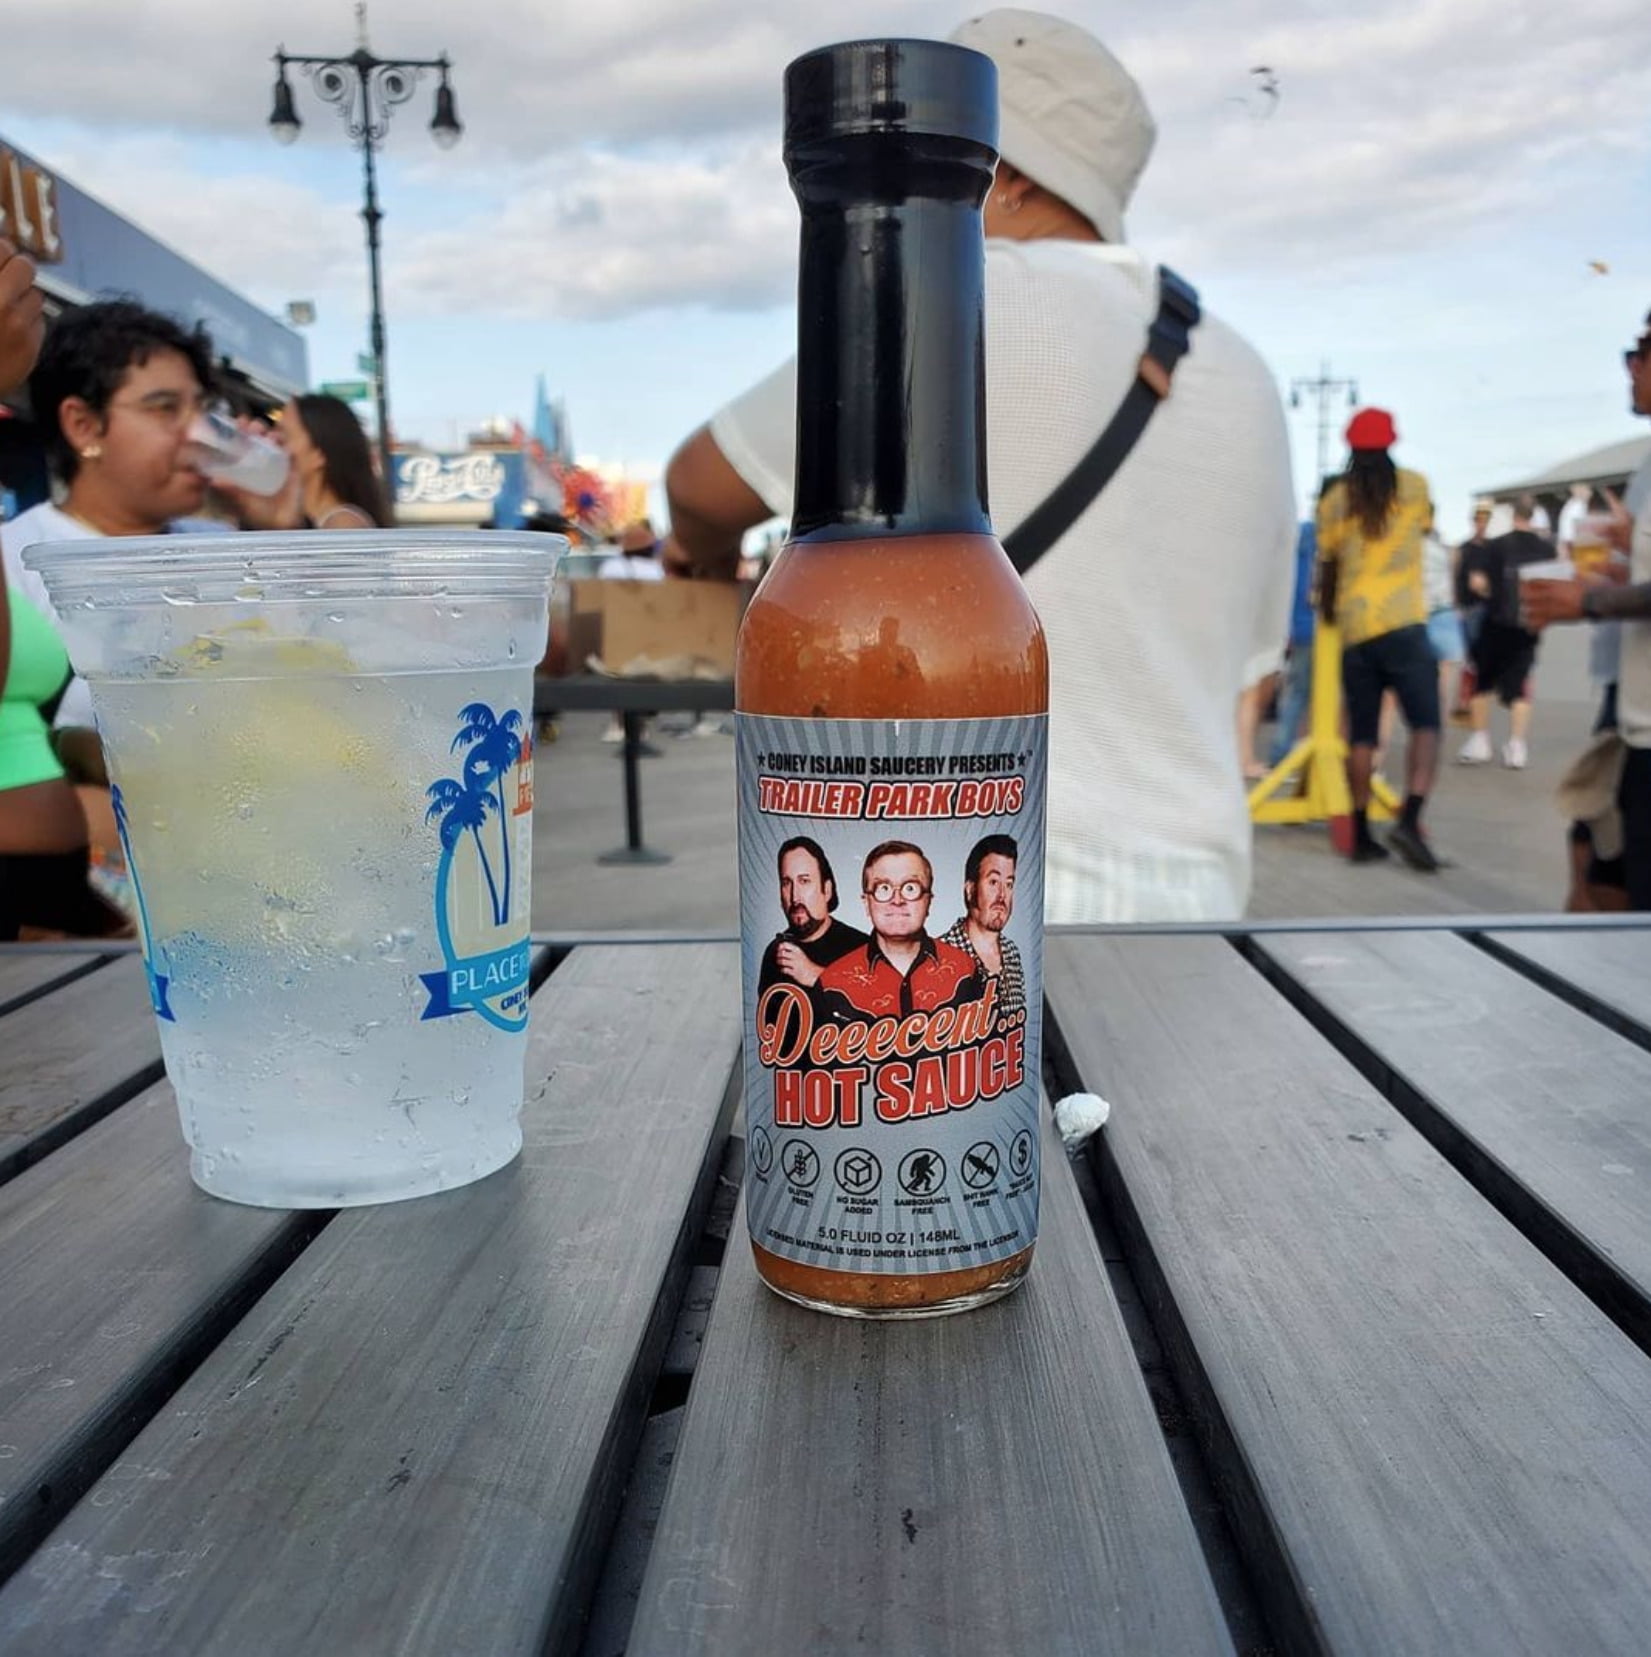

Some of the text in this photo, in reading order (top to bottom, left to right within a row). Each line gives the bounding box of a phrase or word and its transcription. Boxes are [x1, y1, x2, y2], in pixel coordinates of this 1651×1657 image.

[768, 752, 1015, 775] CONEY ISLAND SAUCERY PRESENTS
[760, 776, 1023, 819] TRAILER PARK BOYS
[775, 1027, 1024, 1127] HOT SAUCE
[844, 1206, 873, 1215] ADDED
[911, 1207, 935, 1215] FREE
[818, 1226, 838, 1240] 5.0
[840, 1229, 883, 1243] FLUID
[885, 1231, 907, 1244] OZ
[918, 1228, 961, 1243] 148ML
[796, 1240, 834, 1253] MATERIAL
[835, 1247, 845, 1255] IS
[846, 1247, 872, 1257] USED
[873, 1248, 906, 1258] UNDER
[907, 1247, 947, 1258] LICENSE
[948, 1243, 973, 1254] FROM
[973, 1240, 989, 1251] THE
